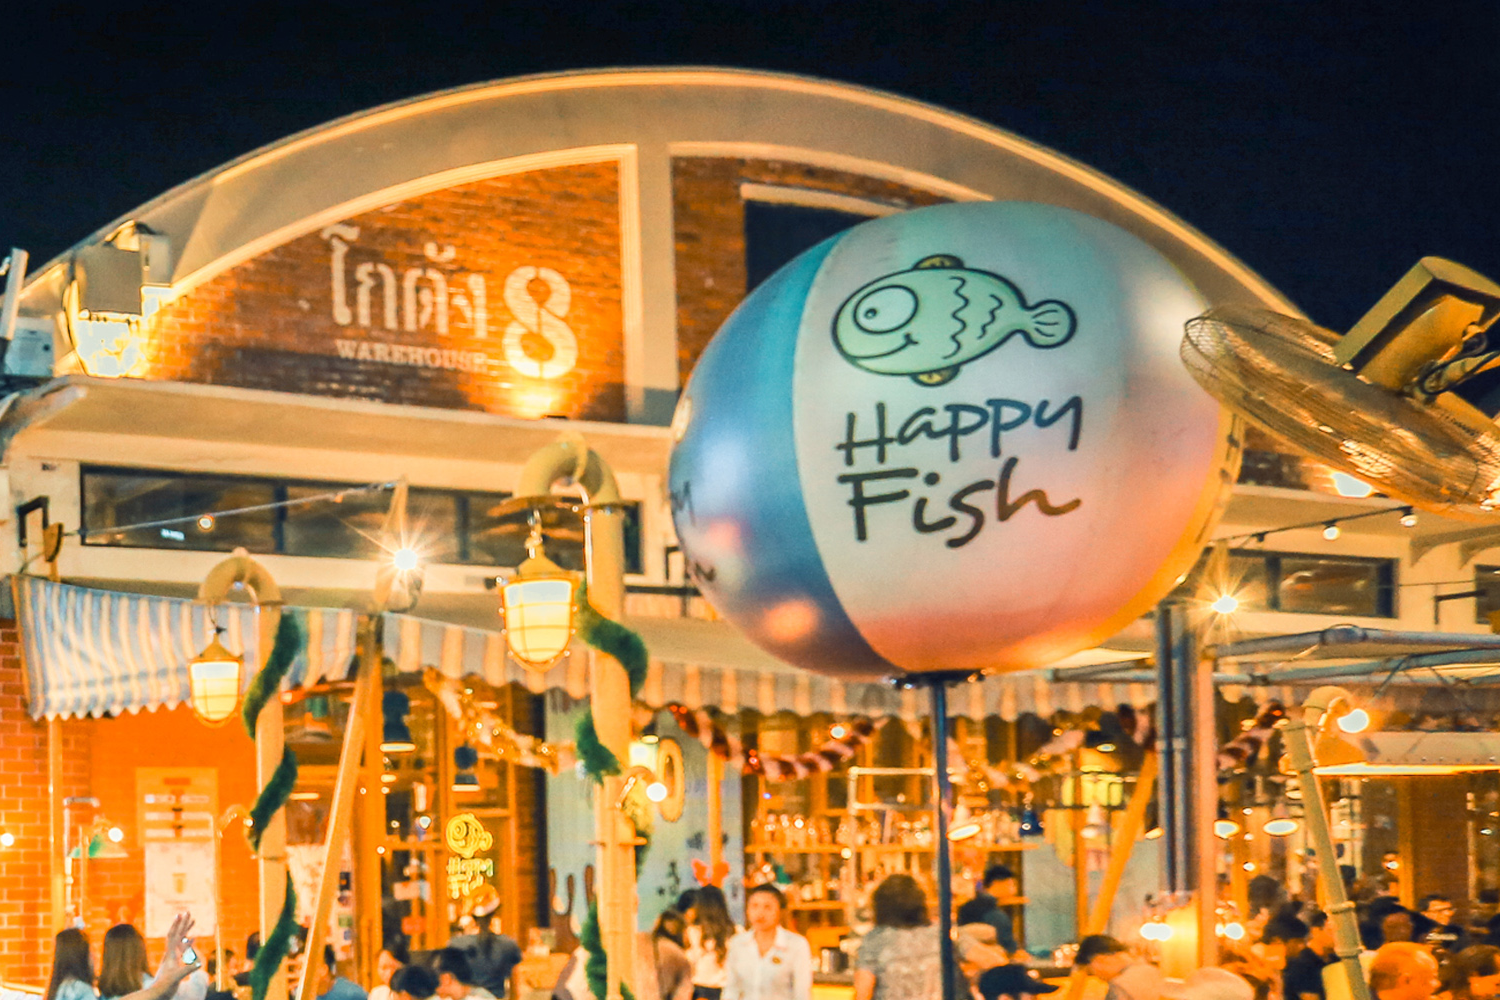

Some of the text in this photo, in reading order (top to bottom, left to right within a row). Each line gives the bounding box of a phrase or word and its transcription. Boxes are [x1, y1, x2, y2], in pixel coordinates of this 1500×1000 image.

[335, 339, 489, 374] WAREHOUSE
[502, 266, 579, 381] 8
[834, 395, 1083, 463] Happy
[836, 455, 1083, 549] Fish
